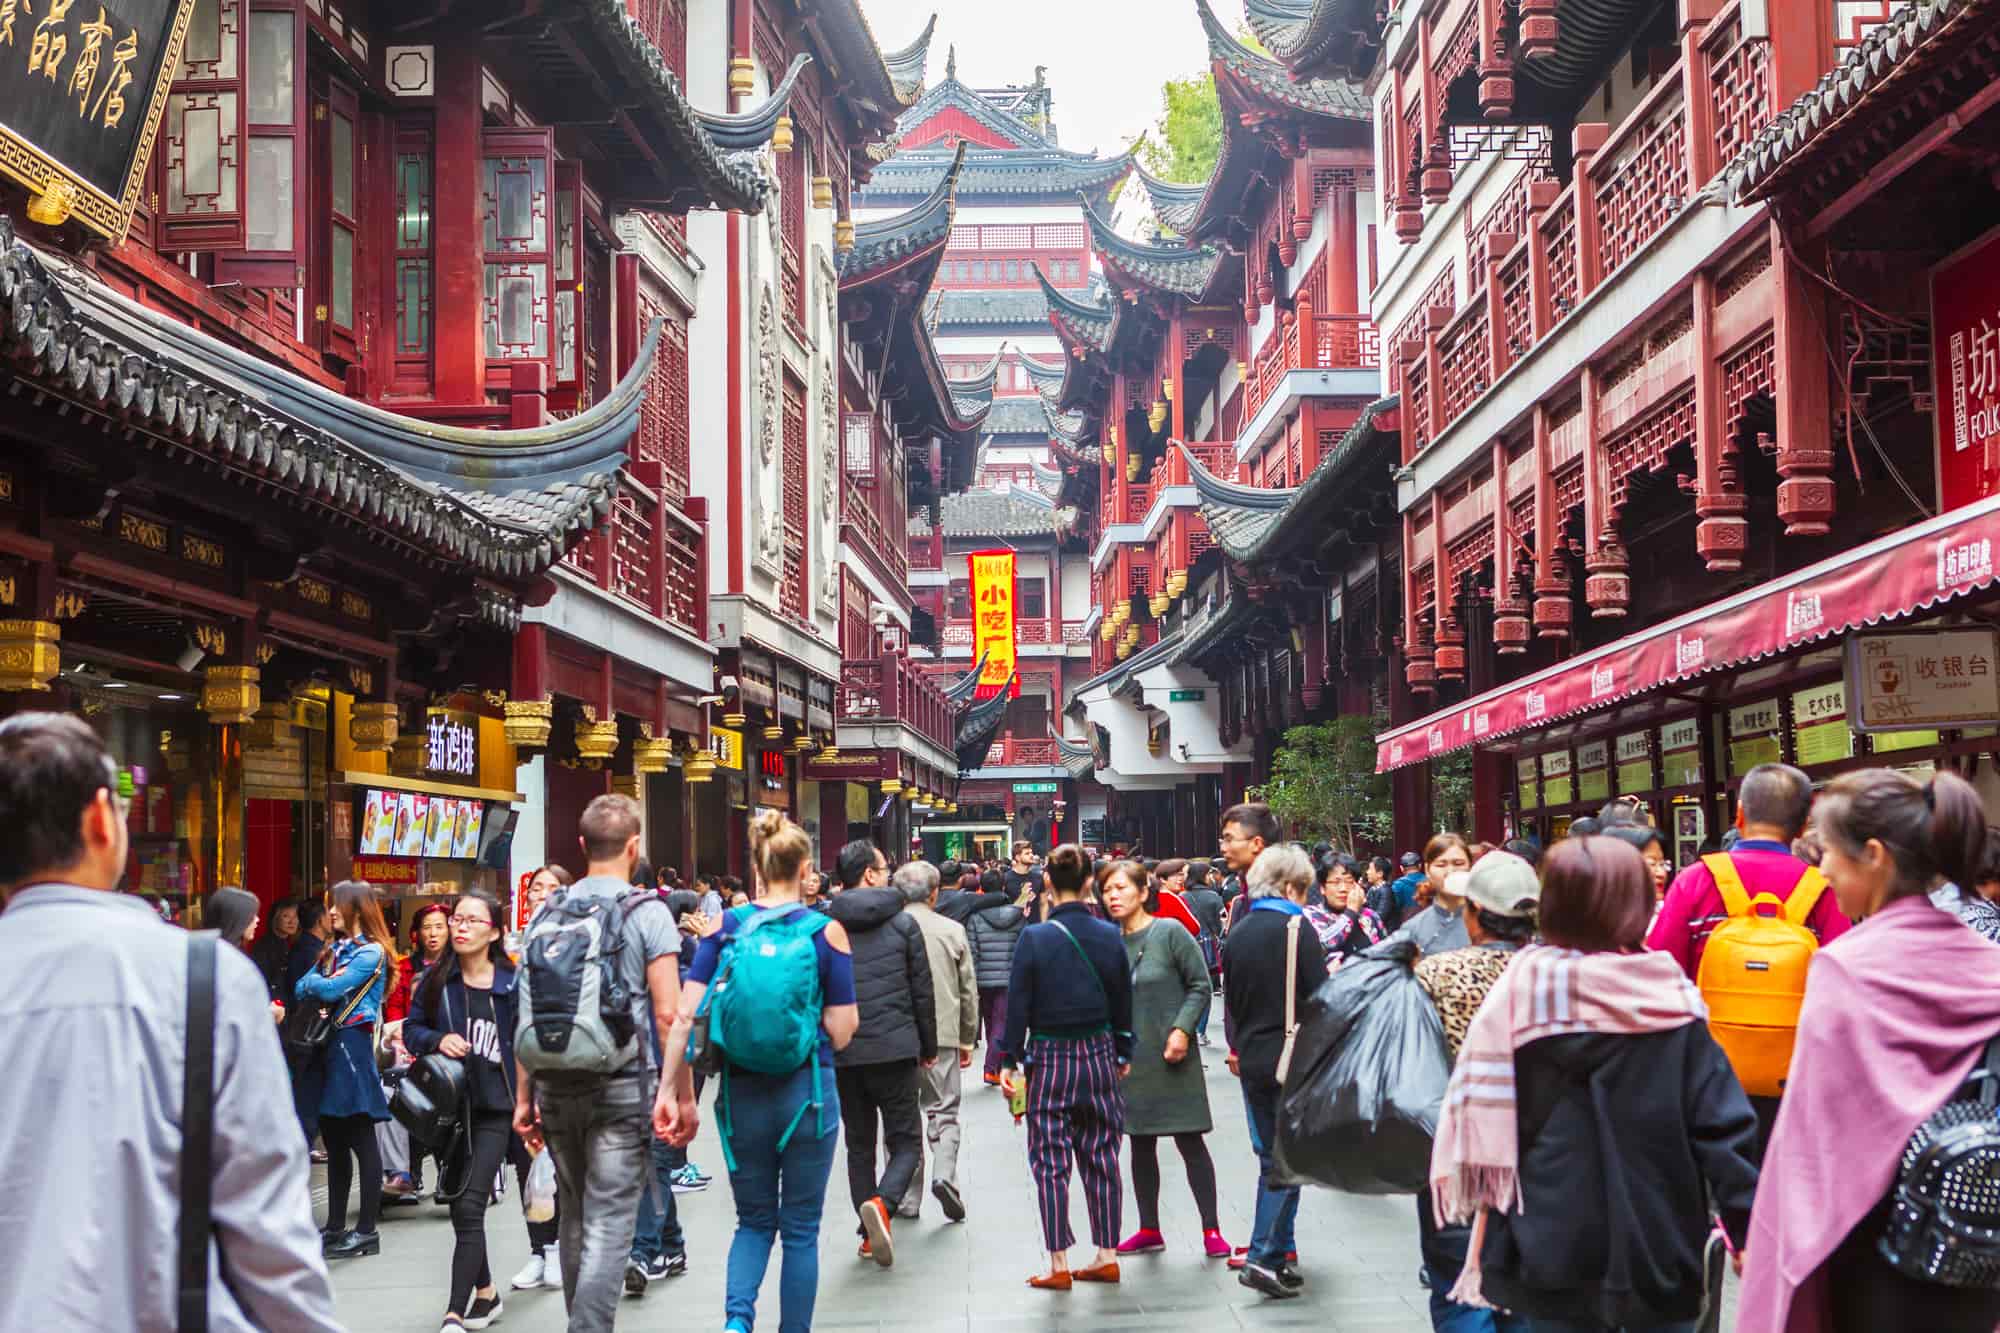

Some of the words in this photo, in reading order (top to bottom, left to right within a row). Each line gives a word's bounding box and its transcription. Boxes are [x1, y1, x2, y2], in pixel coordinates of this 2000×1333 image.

[980, 584, 1009, 681] 小吃广场
[1915, 653, 1989, 679] 收银台
